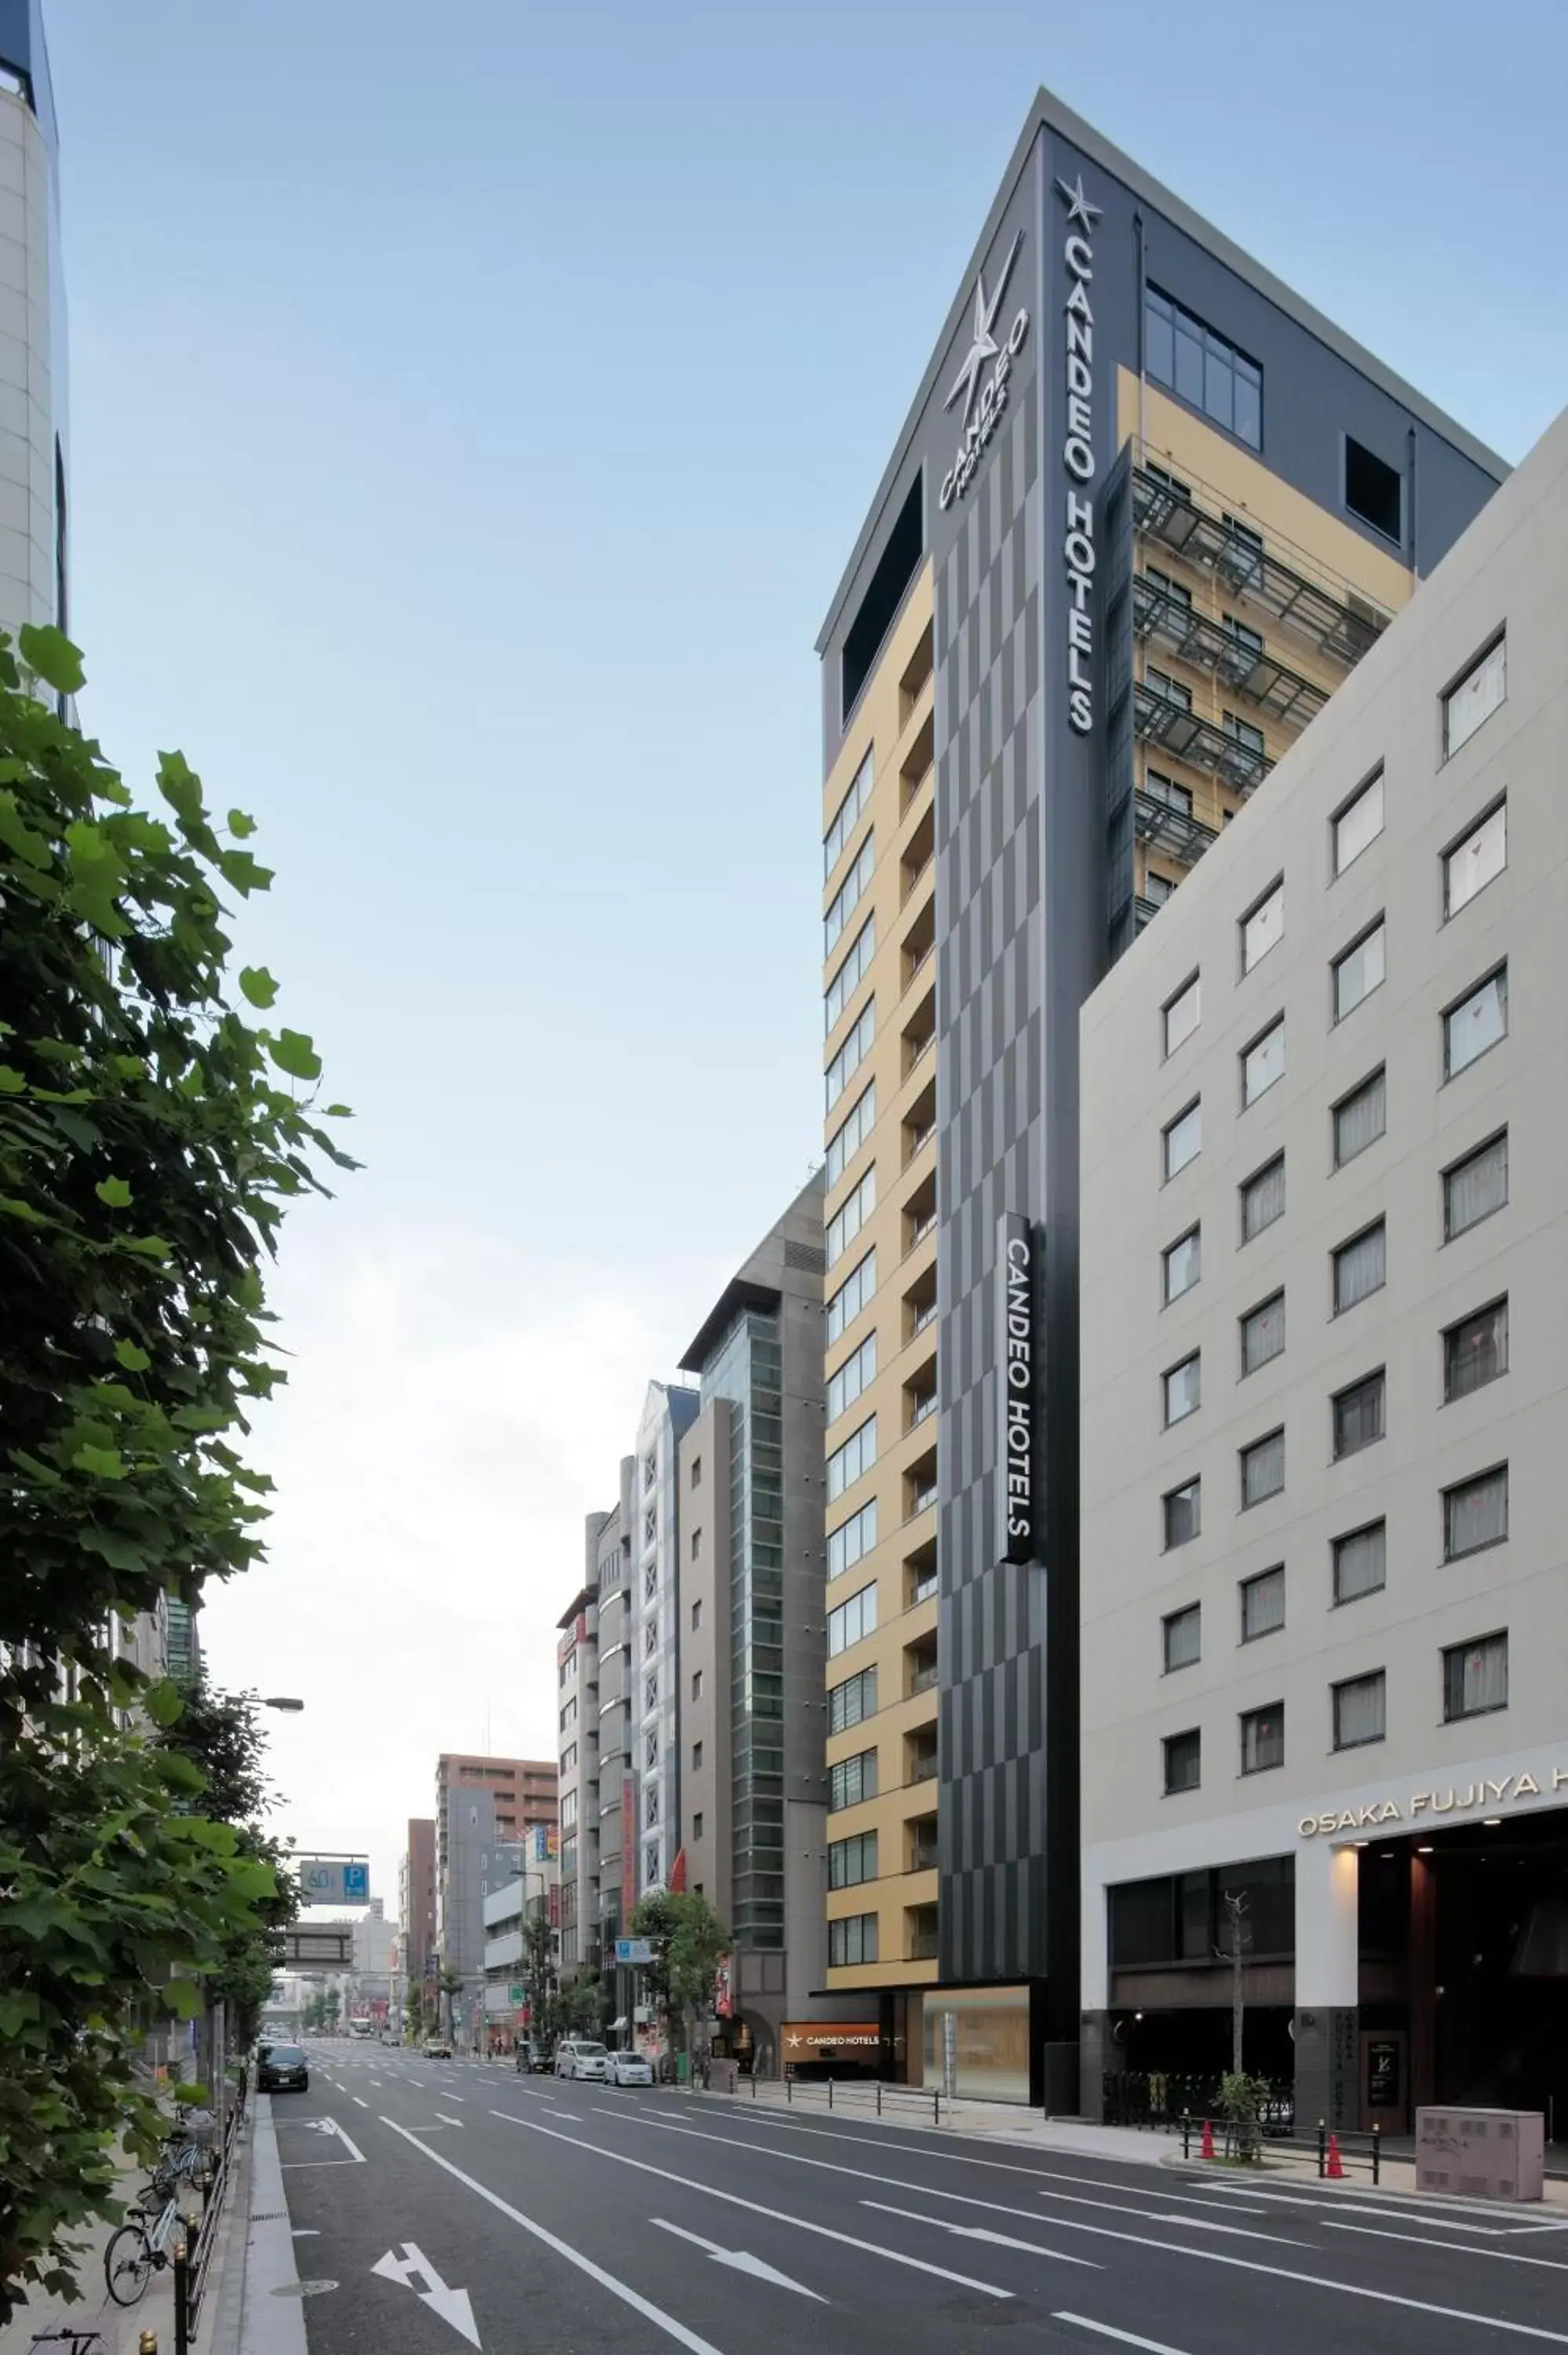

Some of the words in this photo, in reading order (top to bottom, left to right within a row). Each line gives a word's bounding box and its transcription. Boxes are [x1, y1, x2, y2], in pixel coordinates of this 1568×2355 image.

[939, 308, 1029, 510] CANDEO
[1064, 236, 1096, 480] CANDEO
[1064, 490, 1096, 732] HOTELS
[1006, 1238, 1030, 1389] CANDEO
[1006, 1399, 1030, 1539] HOTELS
[350, 1868, 362, 1886] P
[1297, 1801, 1402, 1838] OSAKA
[1410, 1772, 1540, 1816] FUJIYA
[806, 2036, 845, 2045] CANDEO
[845, 2036, 880, 2045] HOTELS
